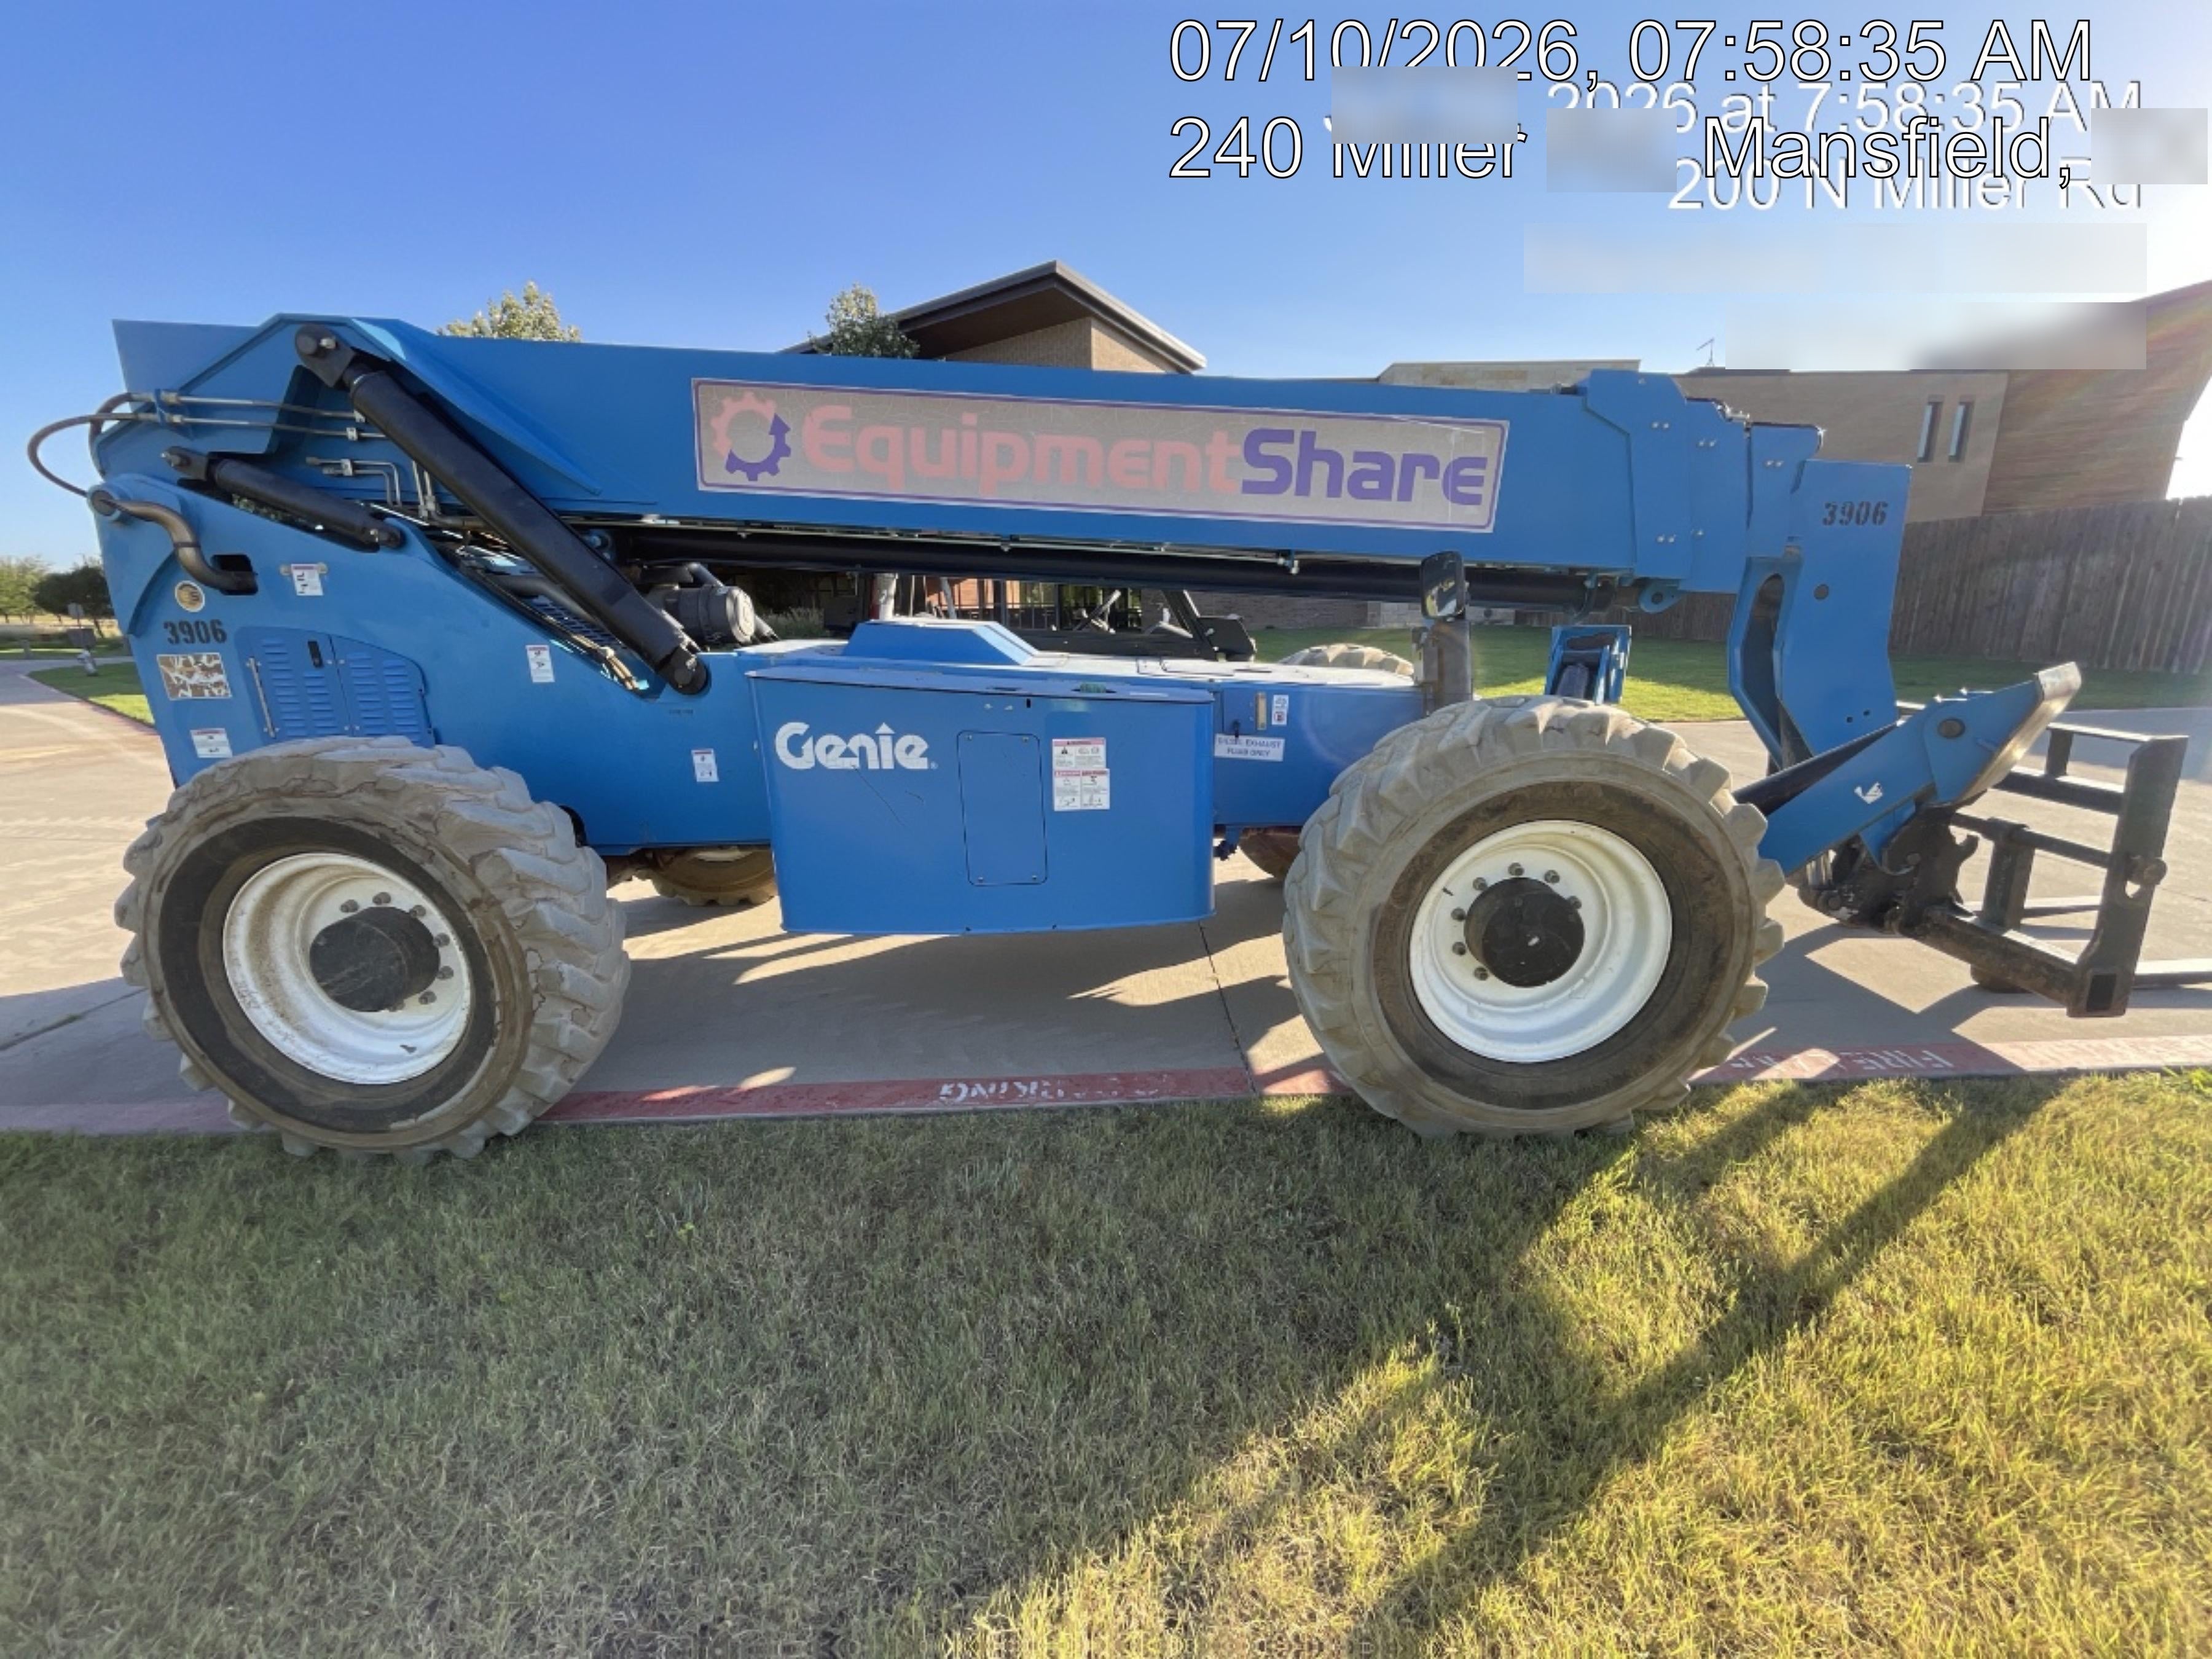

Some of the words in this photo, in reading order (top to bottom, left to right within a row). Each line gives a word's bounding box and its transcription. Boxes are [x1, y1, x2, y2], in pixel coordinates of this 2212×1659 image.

[803, 404, 1488, 506] EquipmentShare
[1822, 501, 1888, 526] 3906
[163, 619, 227, 645] 3906
[775, 721, 929, 769] Genie
